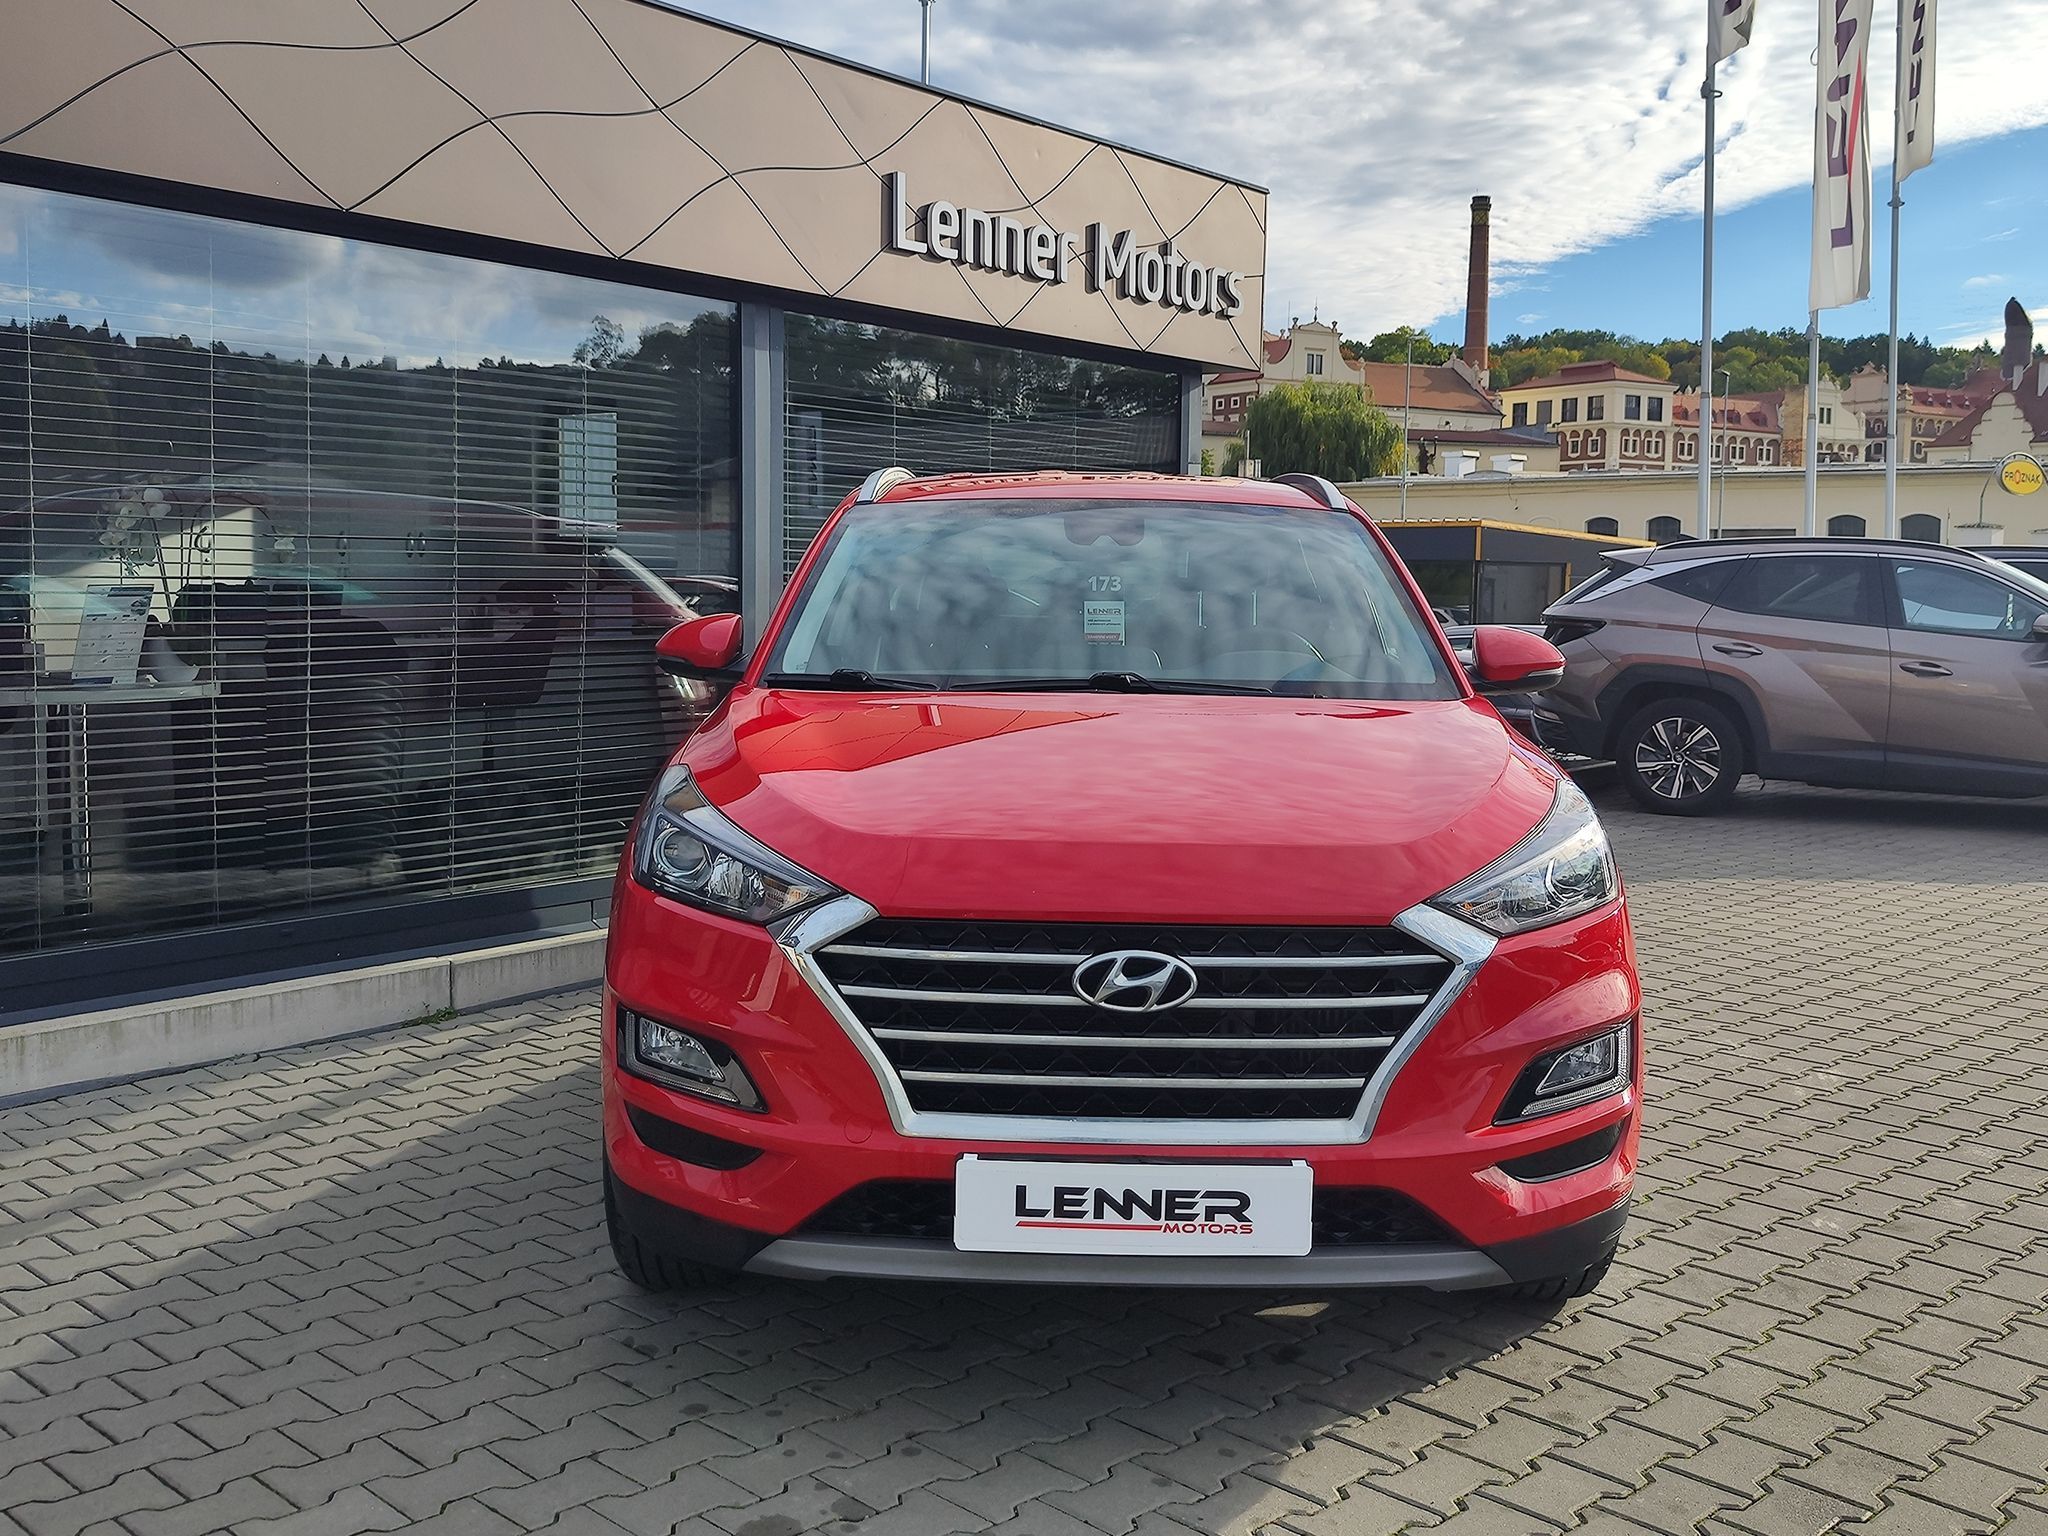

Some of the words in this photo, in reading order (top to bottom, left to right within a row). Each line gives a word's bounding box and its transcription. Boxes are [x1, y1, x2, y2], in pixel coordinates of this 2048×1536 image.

[888, 171, 1079, 284] Lenner
[1092, 222, 1245, 318] Motors
[1088, 575, 1122, 592] 173
[1015, 1184, 1254, 1223] LENNER
[1162, 1222, 1254, 1236] MOTORS
